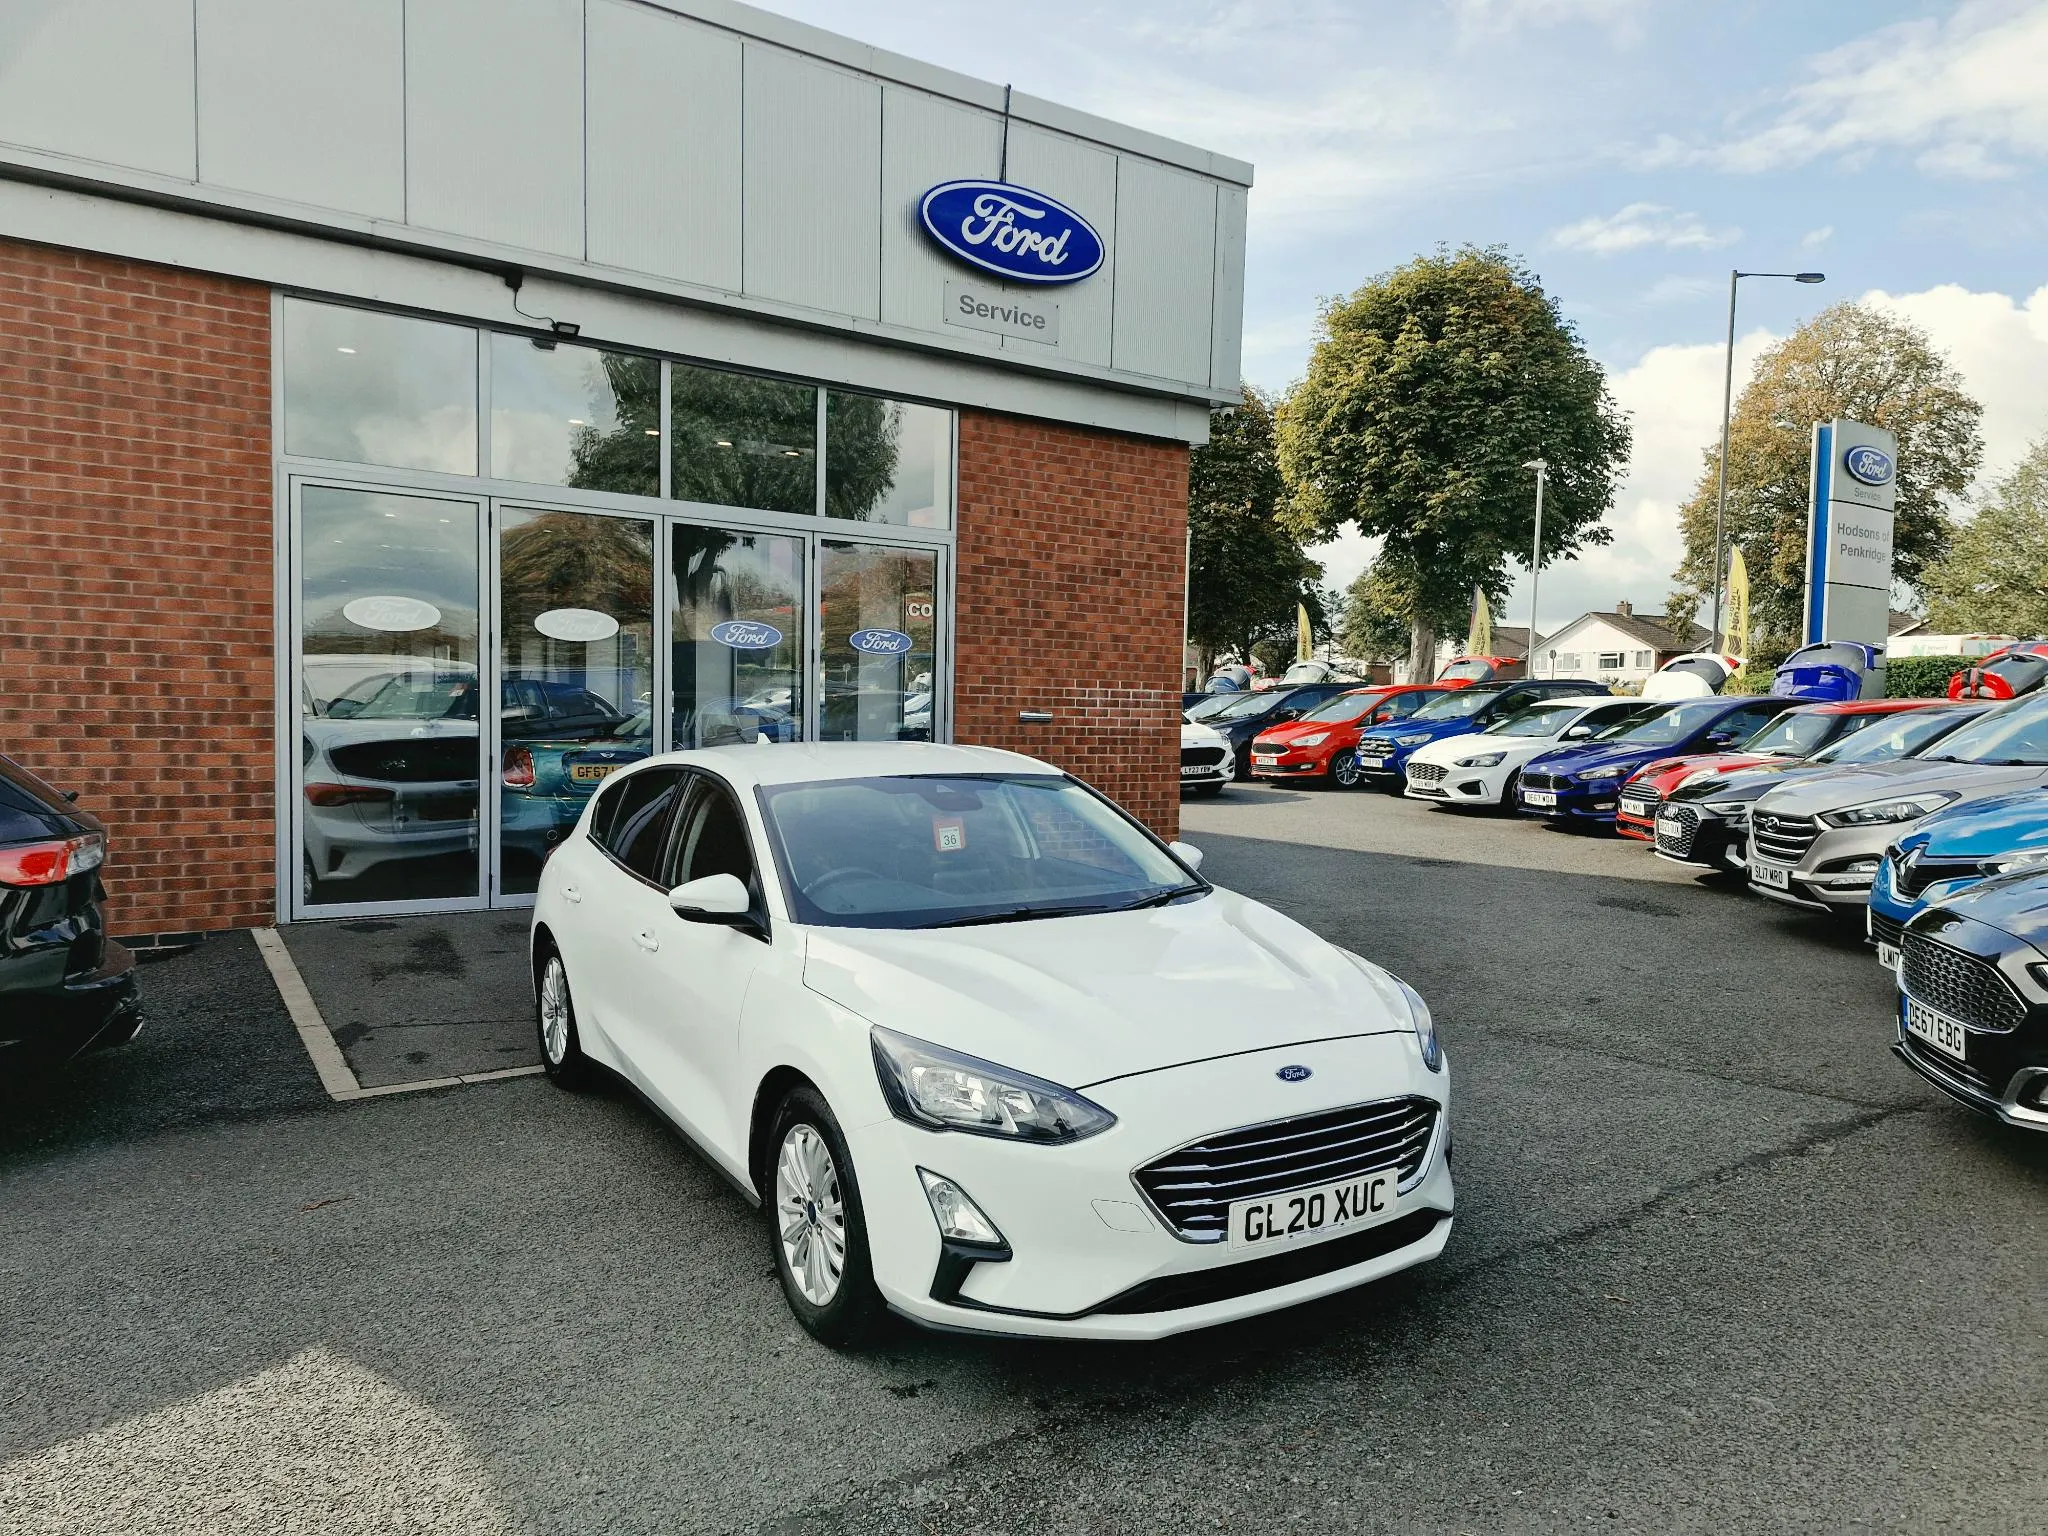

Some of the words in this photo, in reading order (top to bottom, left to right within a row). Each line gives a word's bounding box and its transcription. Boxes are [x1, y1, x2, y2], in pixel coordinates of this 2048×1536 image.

[961, 193, 1072, 266] Ford
[959, 294, 1046, 330] Service
[1858, 451, 1888, 479] Ford
[1854, 486, 1881, 501] Service
[1837, 522, 1880, 541] Hodsons
[1881, 530, 1890, 542] of
[1840, 543, 1886, 564] Penkridge
[364, 600, 423, 624] Ford
[906, 603, 933, 617] CO
[724, 623, 768, 645] Ford
[861, 630, 901, 650] Ford
[577, 766, 608, 778] GF67
[943, 834, 957, 846] 36
[1755, 865, 1768, 881] SL17
[1908, 1001, 1934, 1038] DE67
[1937, 1017, 1961, 1052] EBG
[1284, 1068, 1306, 1080] Ford
[1244, 1193, 1325, 1242] GL20
[1333, 1178, 1386, 1223] XUC
